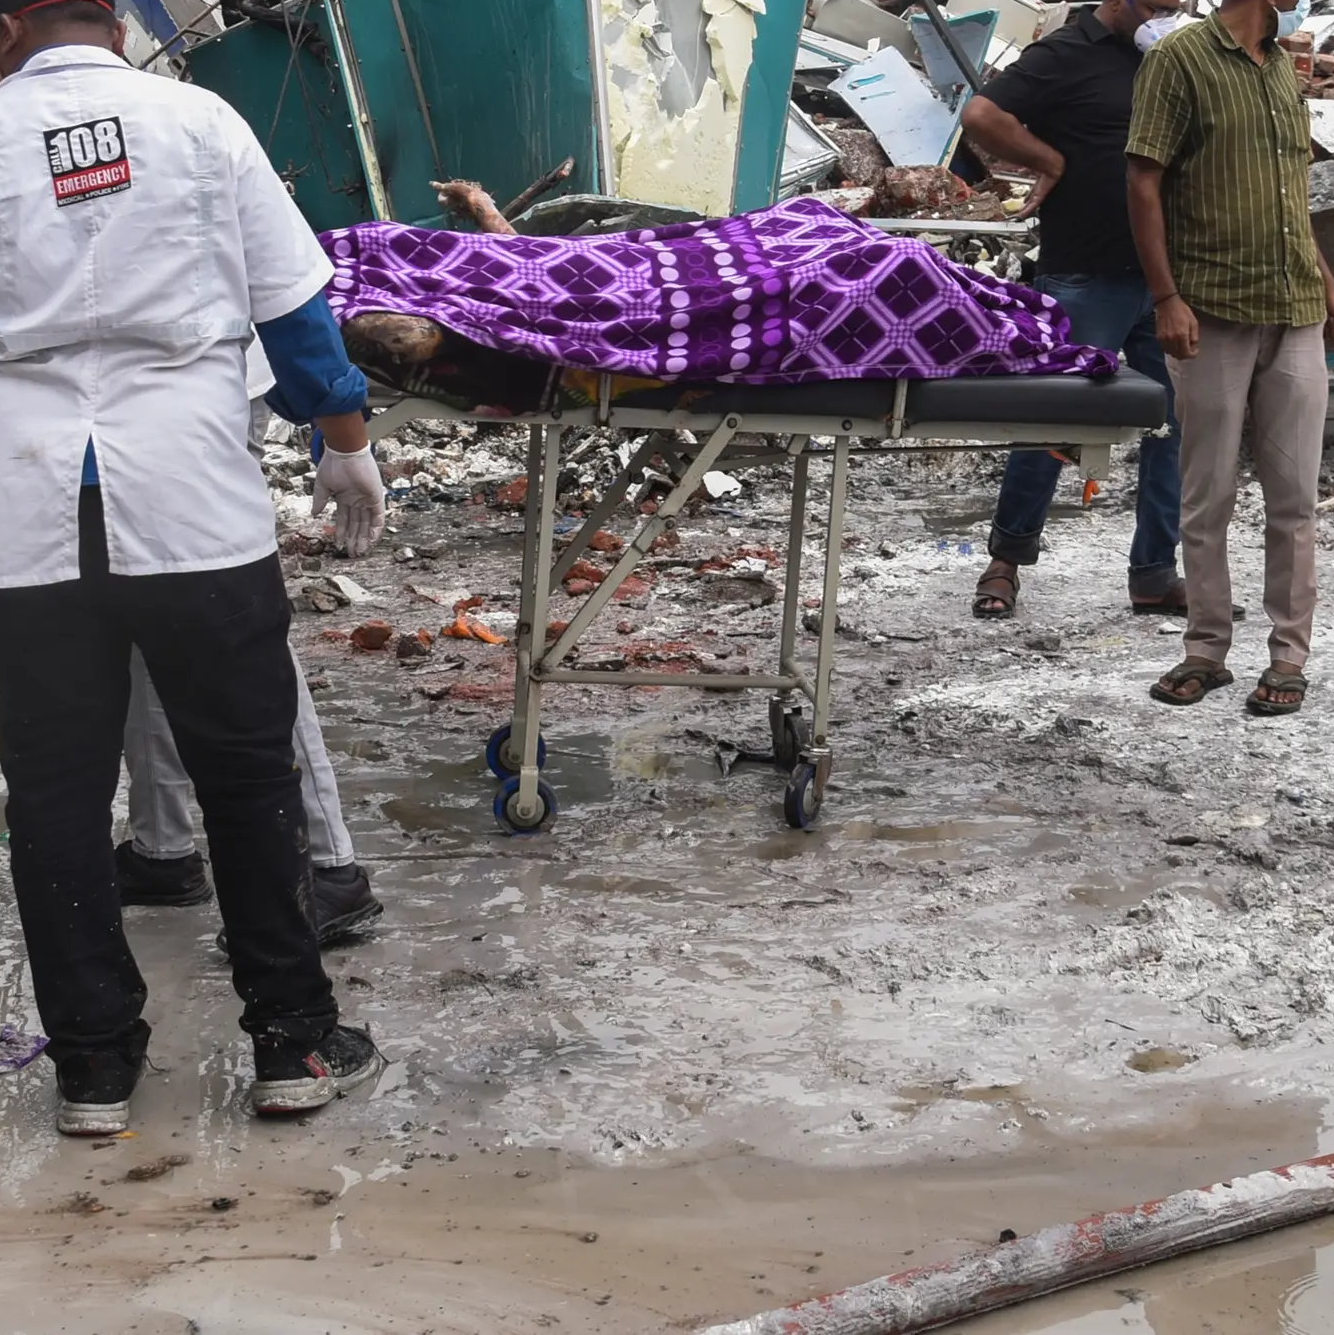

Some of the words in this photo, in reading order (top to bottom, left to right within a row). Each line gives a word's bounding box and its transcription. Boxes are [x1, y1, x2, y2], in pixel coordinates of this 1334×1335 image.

[48, 147, 64, 174] CALL
[49, 120, 122, 172] 108
[56, 163, 127, 195] EMERGENCY
